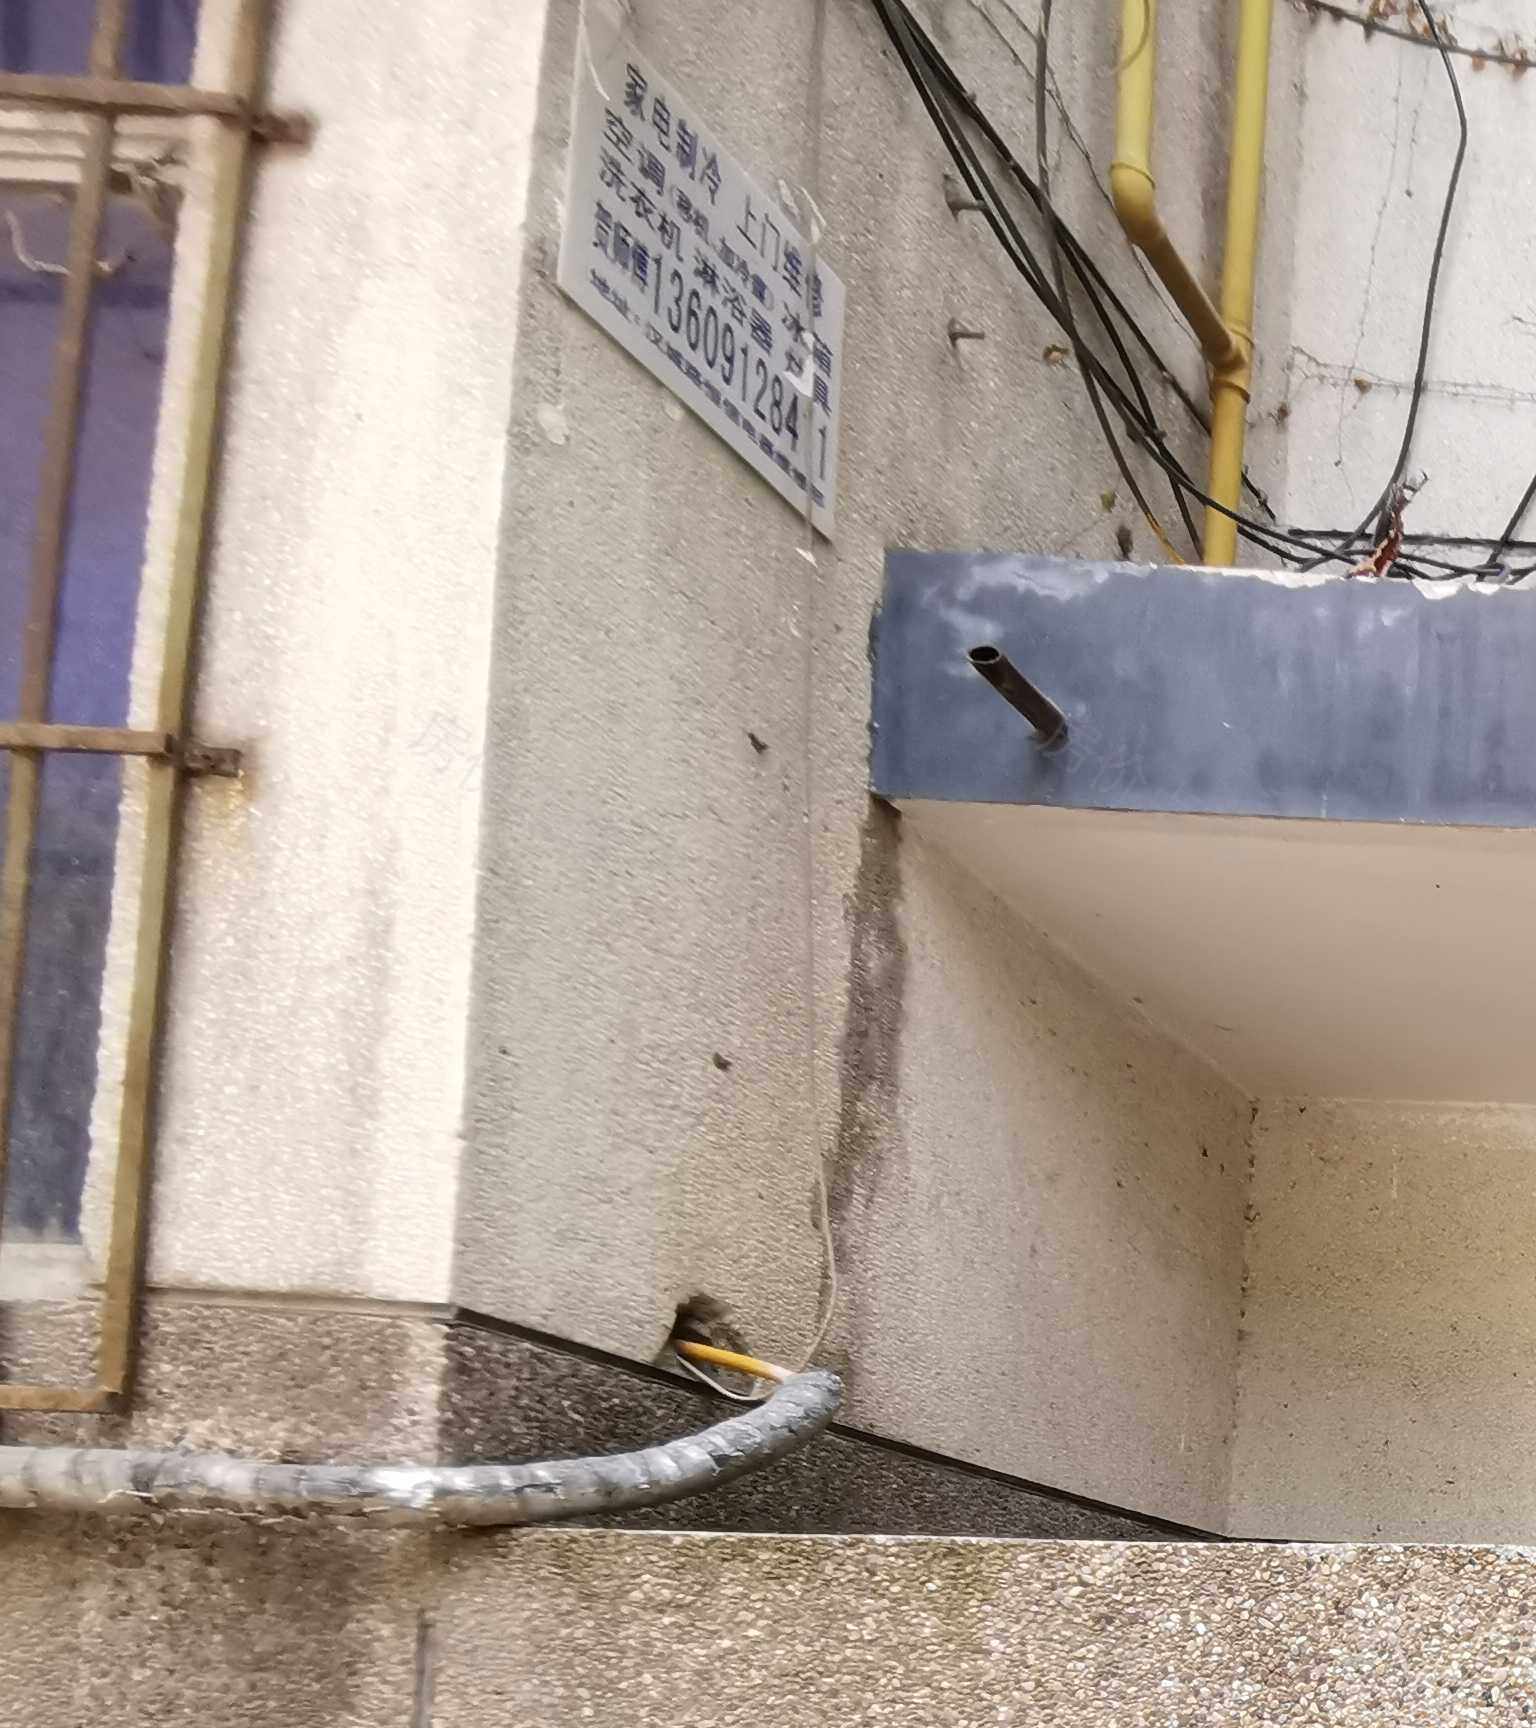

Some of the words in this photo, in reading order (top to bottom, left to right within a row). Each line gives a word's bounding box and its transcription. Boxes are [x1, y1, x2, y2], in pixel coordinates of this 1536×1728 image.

[624, 62, 722, 207] 家电制冷
[599, 146, 684, 262] 洗衣机
